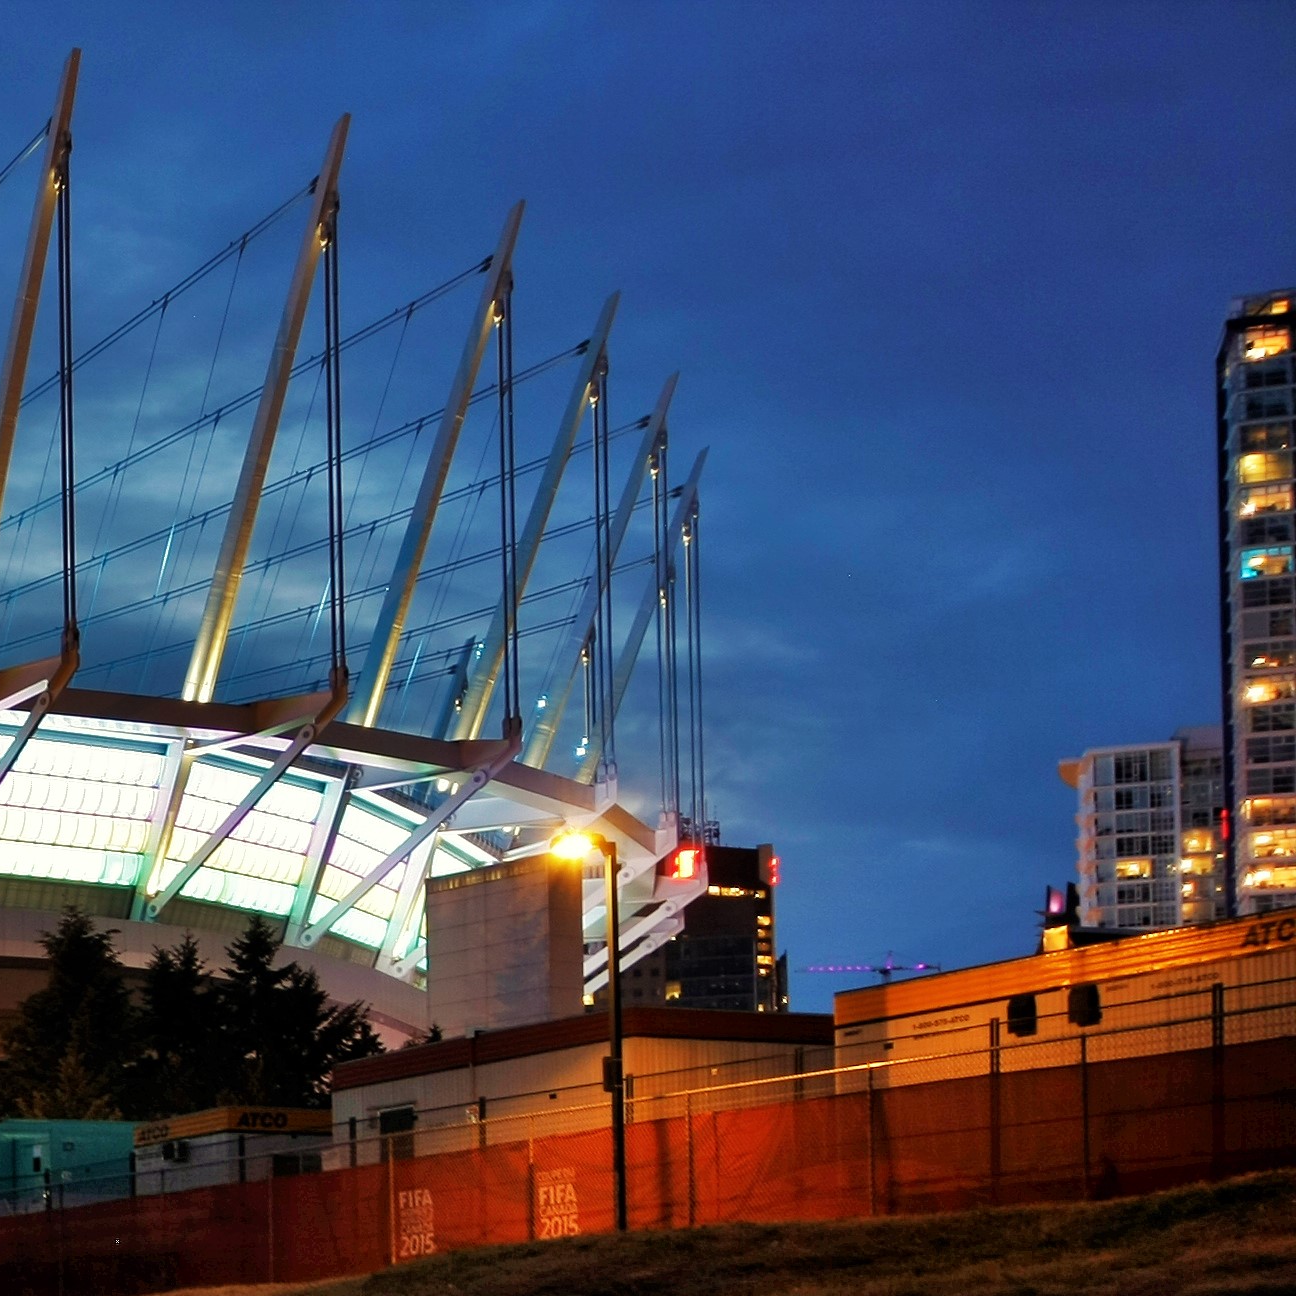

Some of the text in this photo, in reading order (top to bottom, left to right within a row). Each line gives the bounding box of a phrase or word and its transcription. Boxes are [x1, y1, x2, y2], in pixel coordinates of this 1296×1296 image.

[238, 1112, 288, 1128] ATCO
[140, 1124, 169, 1141] ATCO
[399, 1189, 433, 1209] FIFA
[538, 1183, 577, 1207] FIFA
[539, 1214, 580, 1239] 2015
[400, 1232, 435, 1257] 2015
